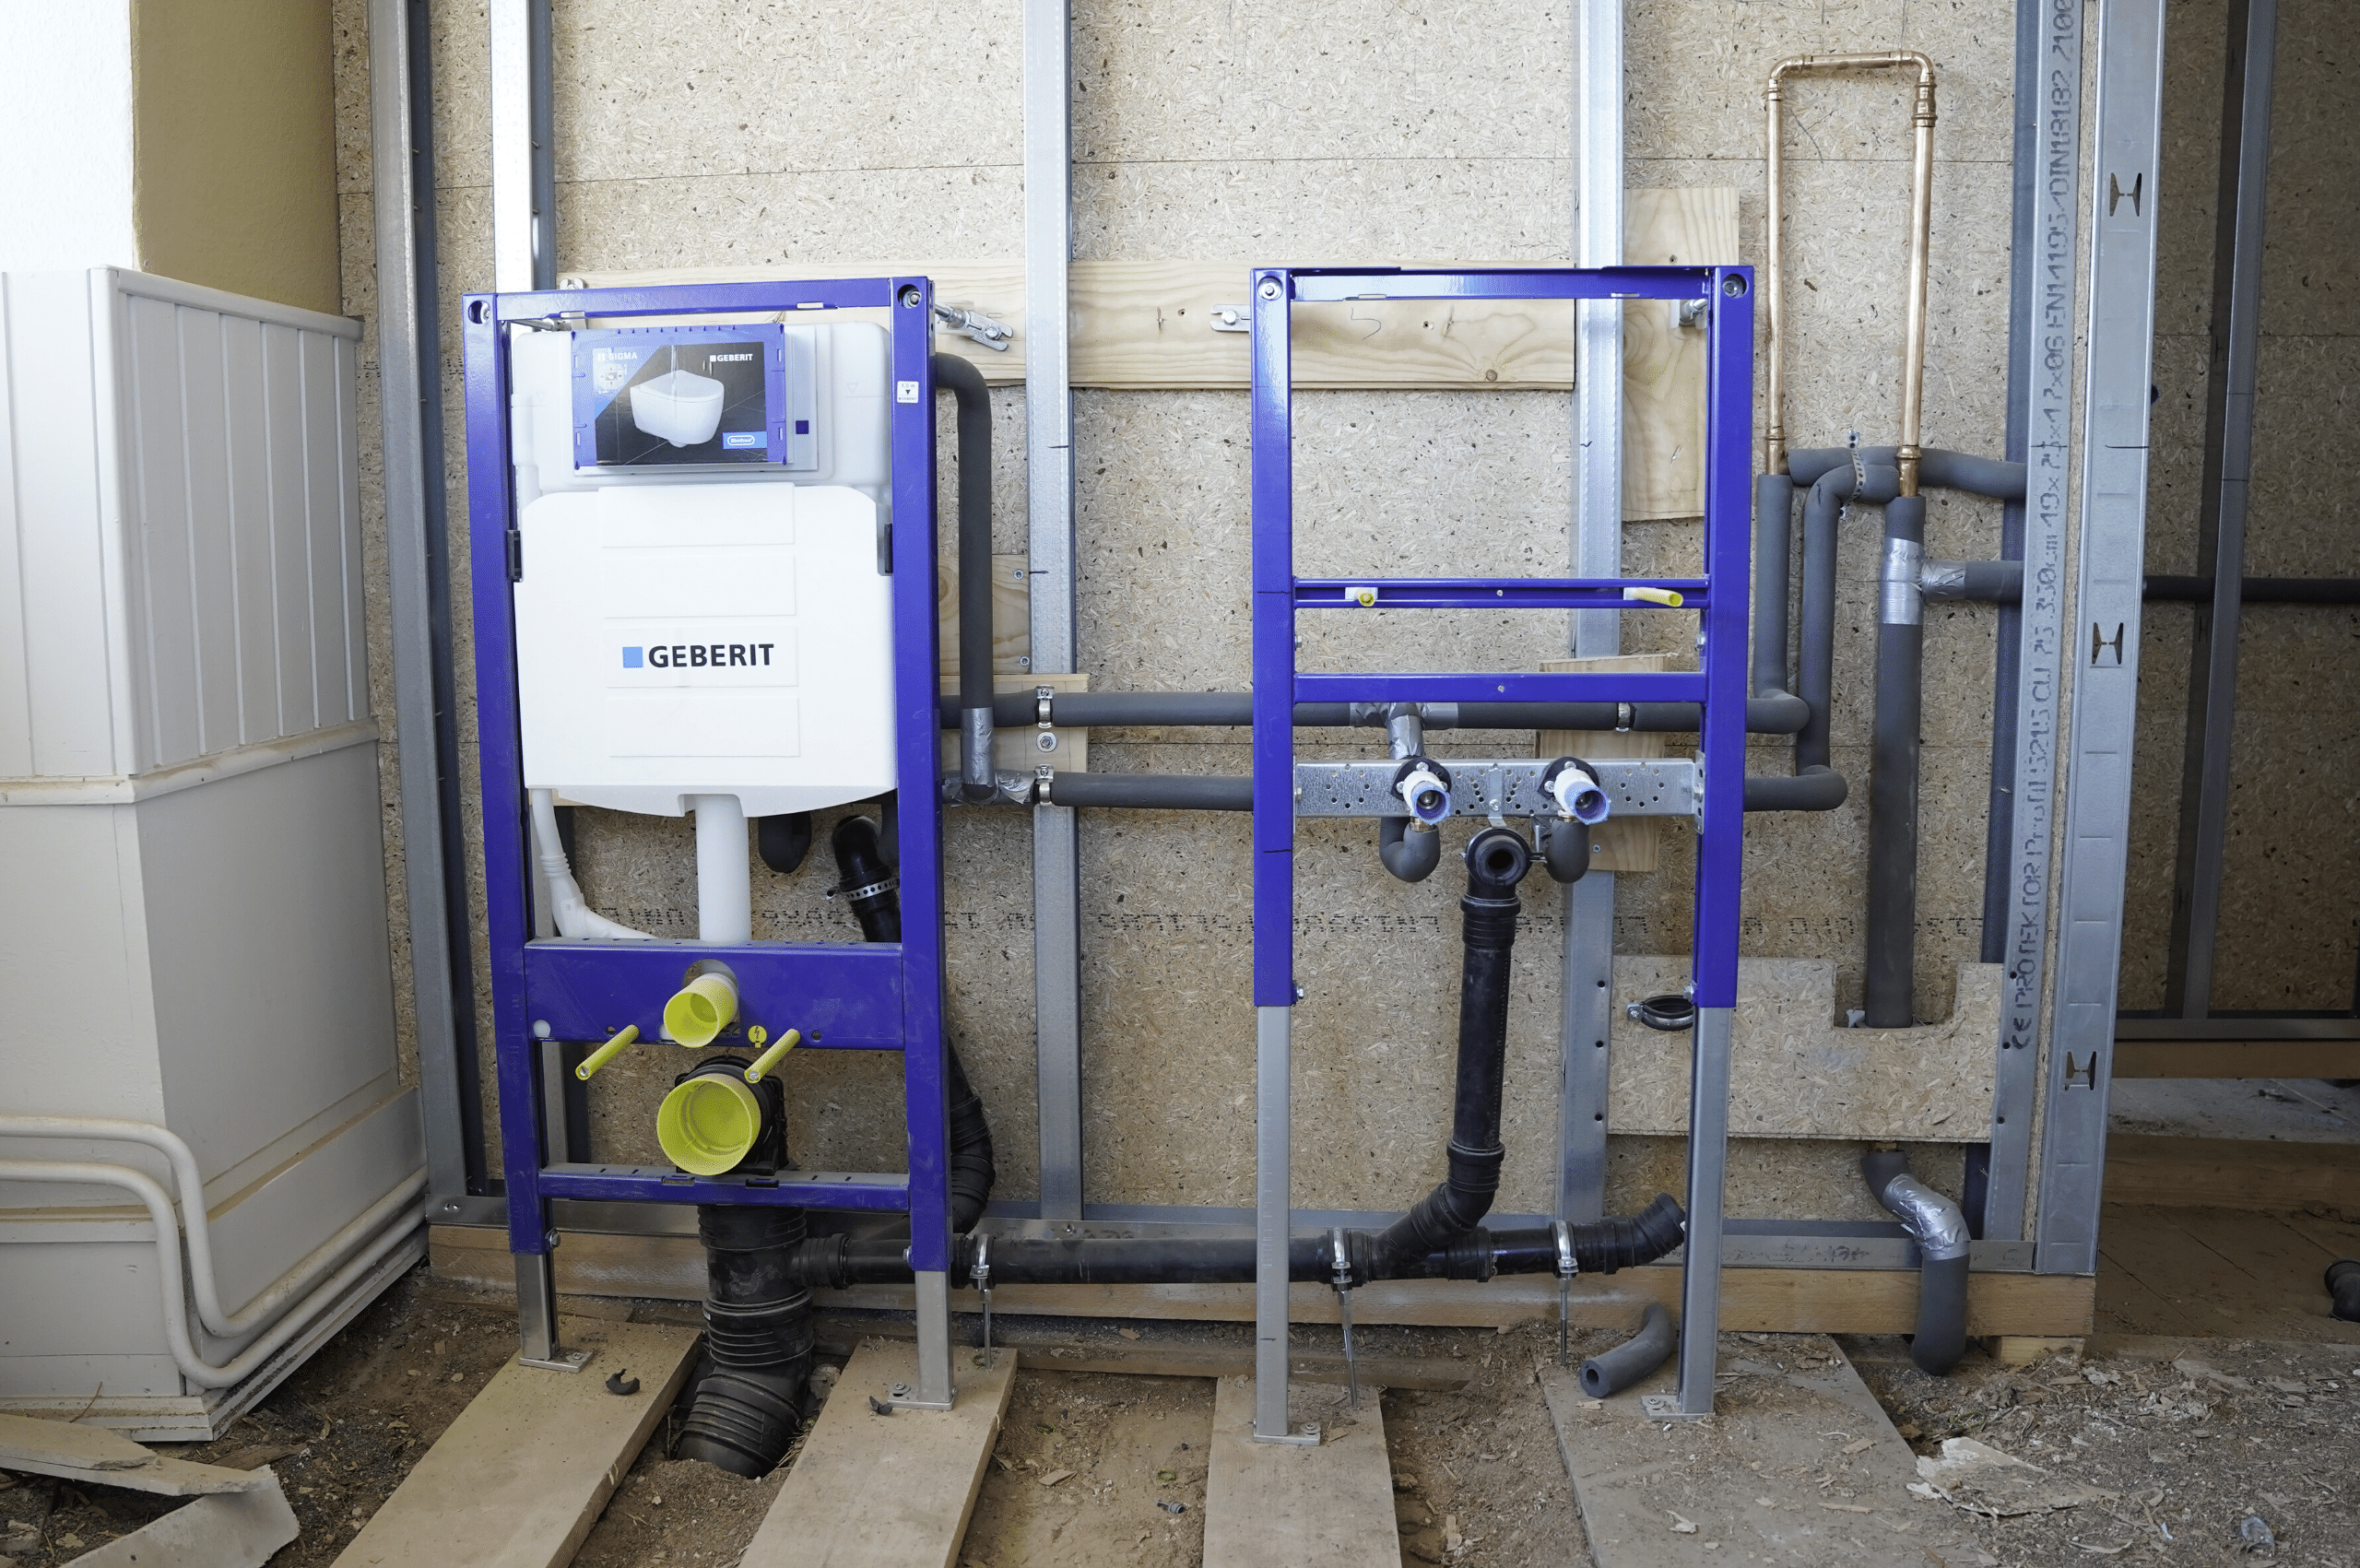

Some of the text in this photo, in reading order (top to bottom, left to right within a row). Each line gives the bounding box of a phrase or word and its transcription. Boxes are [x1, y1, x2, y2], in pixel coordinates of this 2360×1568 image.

[608, 352, 638, 360] SIGMA
[716, 353, 753, 362] GEBERIT
[648, 643, 774, 669] GEBERIT
[2014, 861, 2042, 1008] PROTEKTOR
